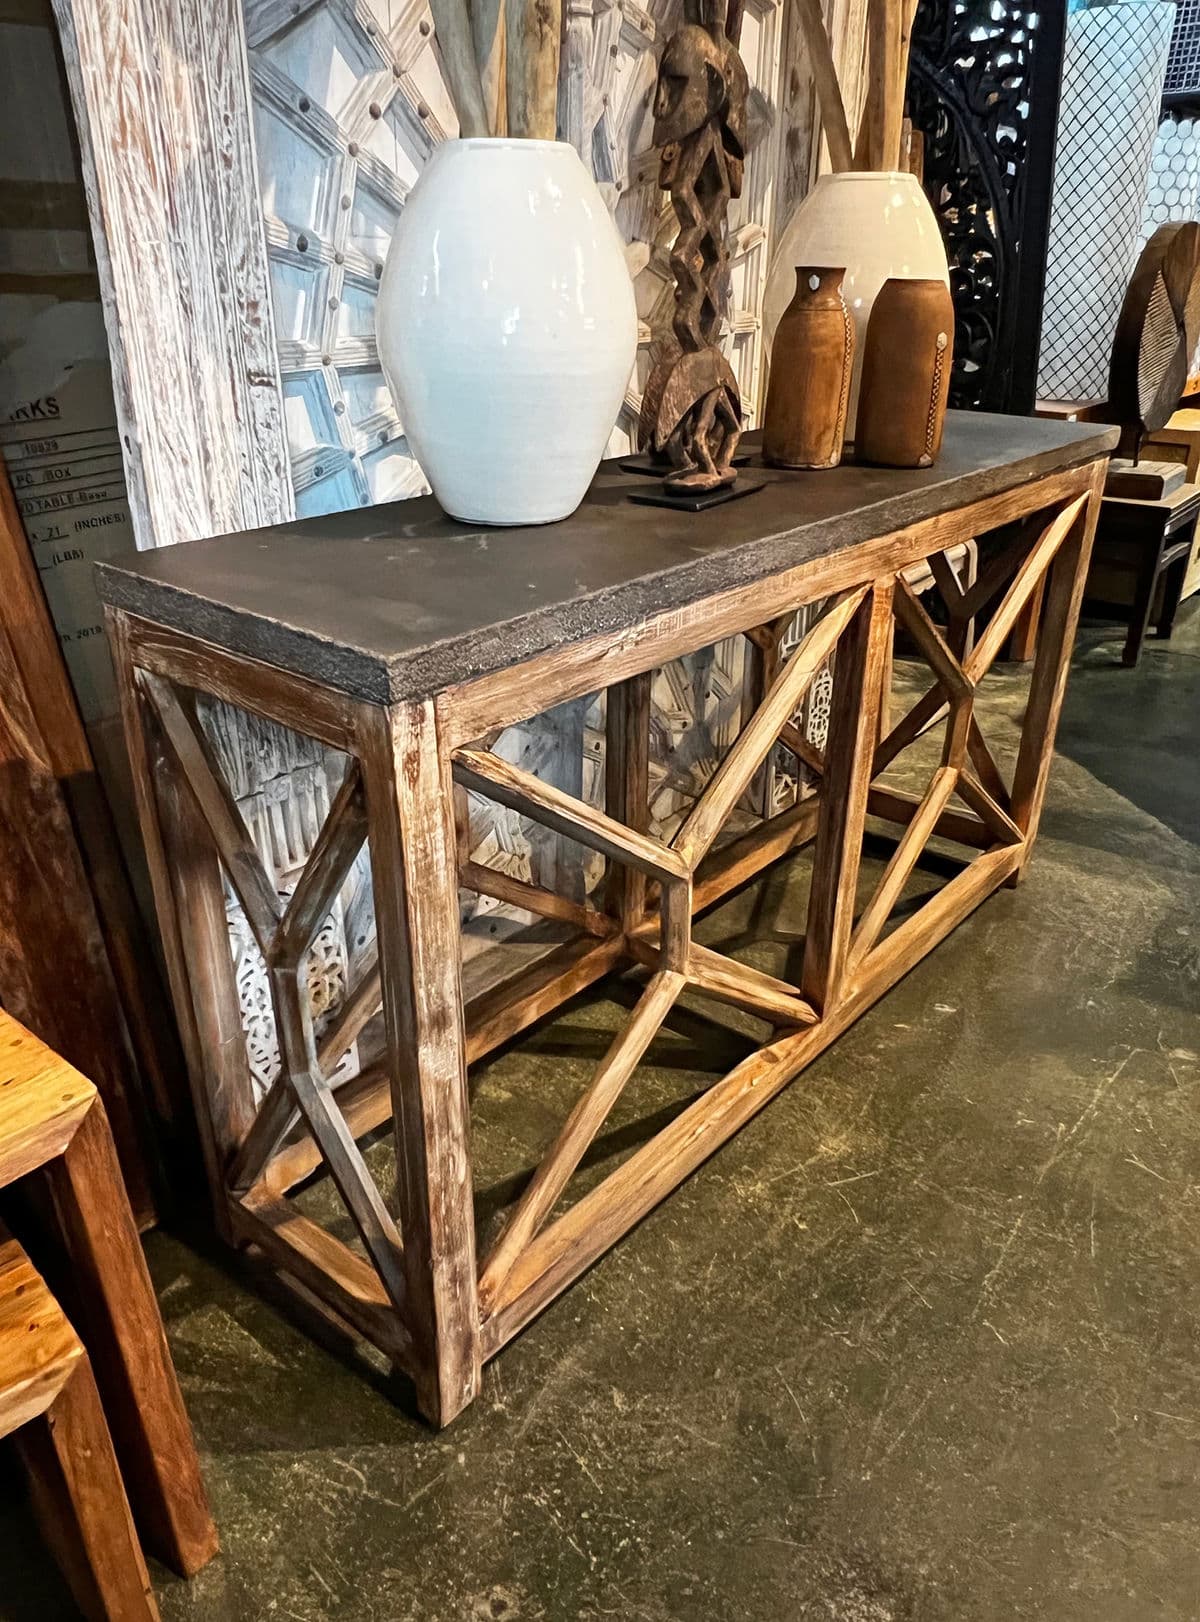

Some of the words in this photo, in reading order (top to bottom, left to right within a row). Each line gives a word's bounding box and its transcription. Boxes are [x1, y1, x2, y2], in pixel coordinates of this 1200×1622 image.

[43, 467, 72, 481] BOX
[38, 493, 75, 510] TABLE
[74, 512, 126, 532] (INCHES)
[52, 549, 85, 566] (LBS)
